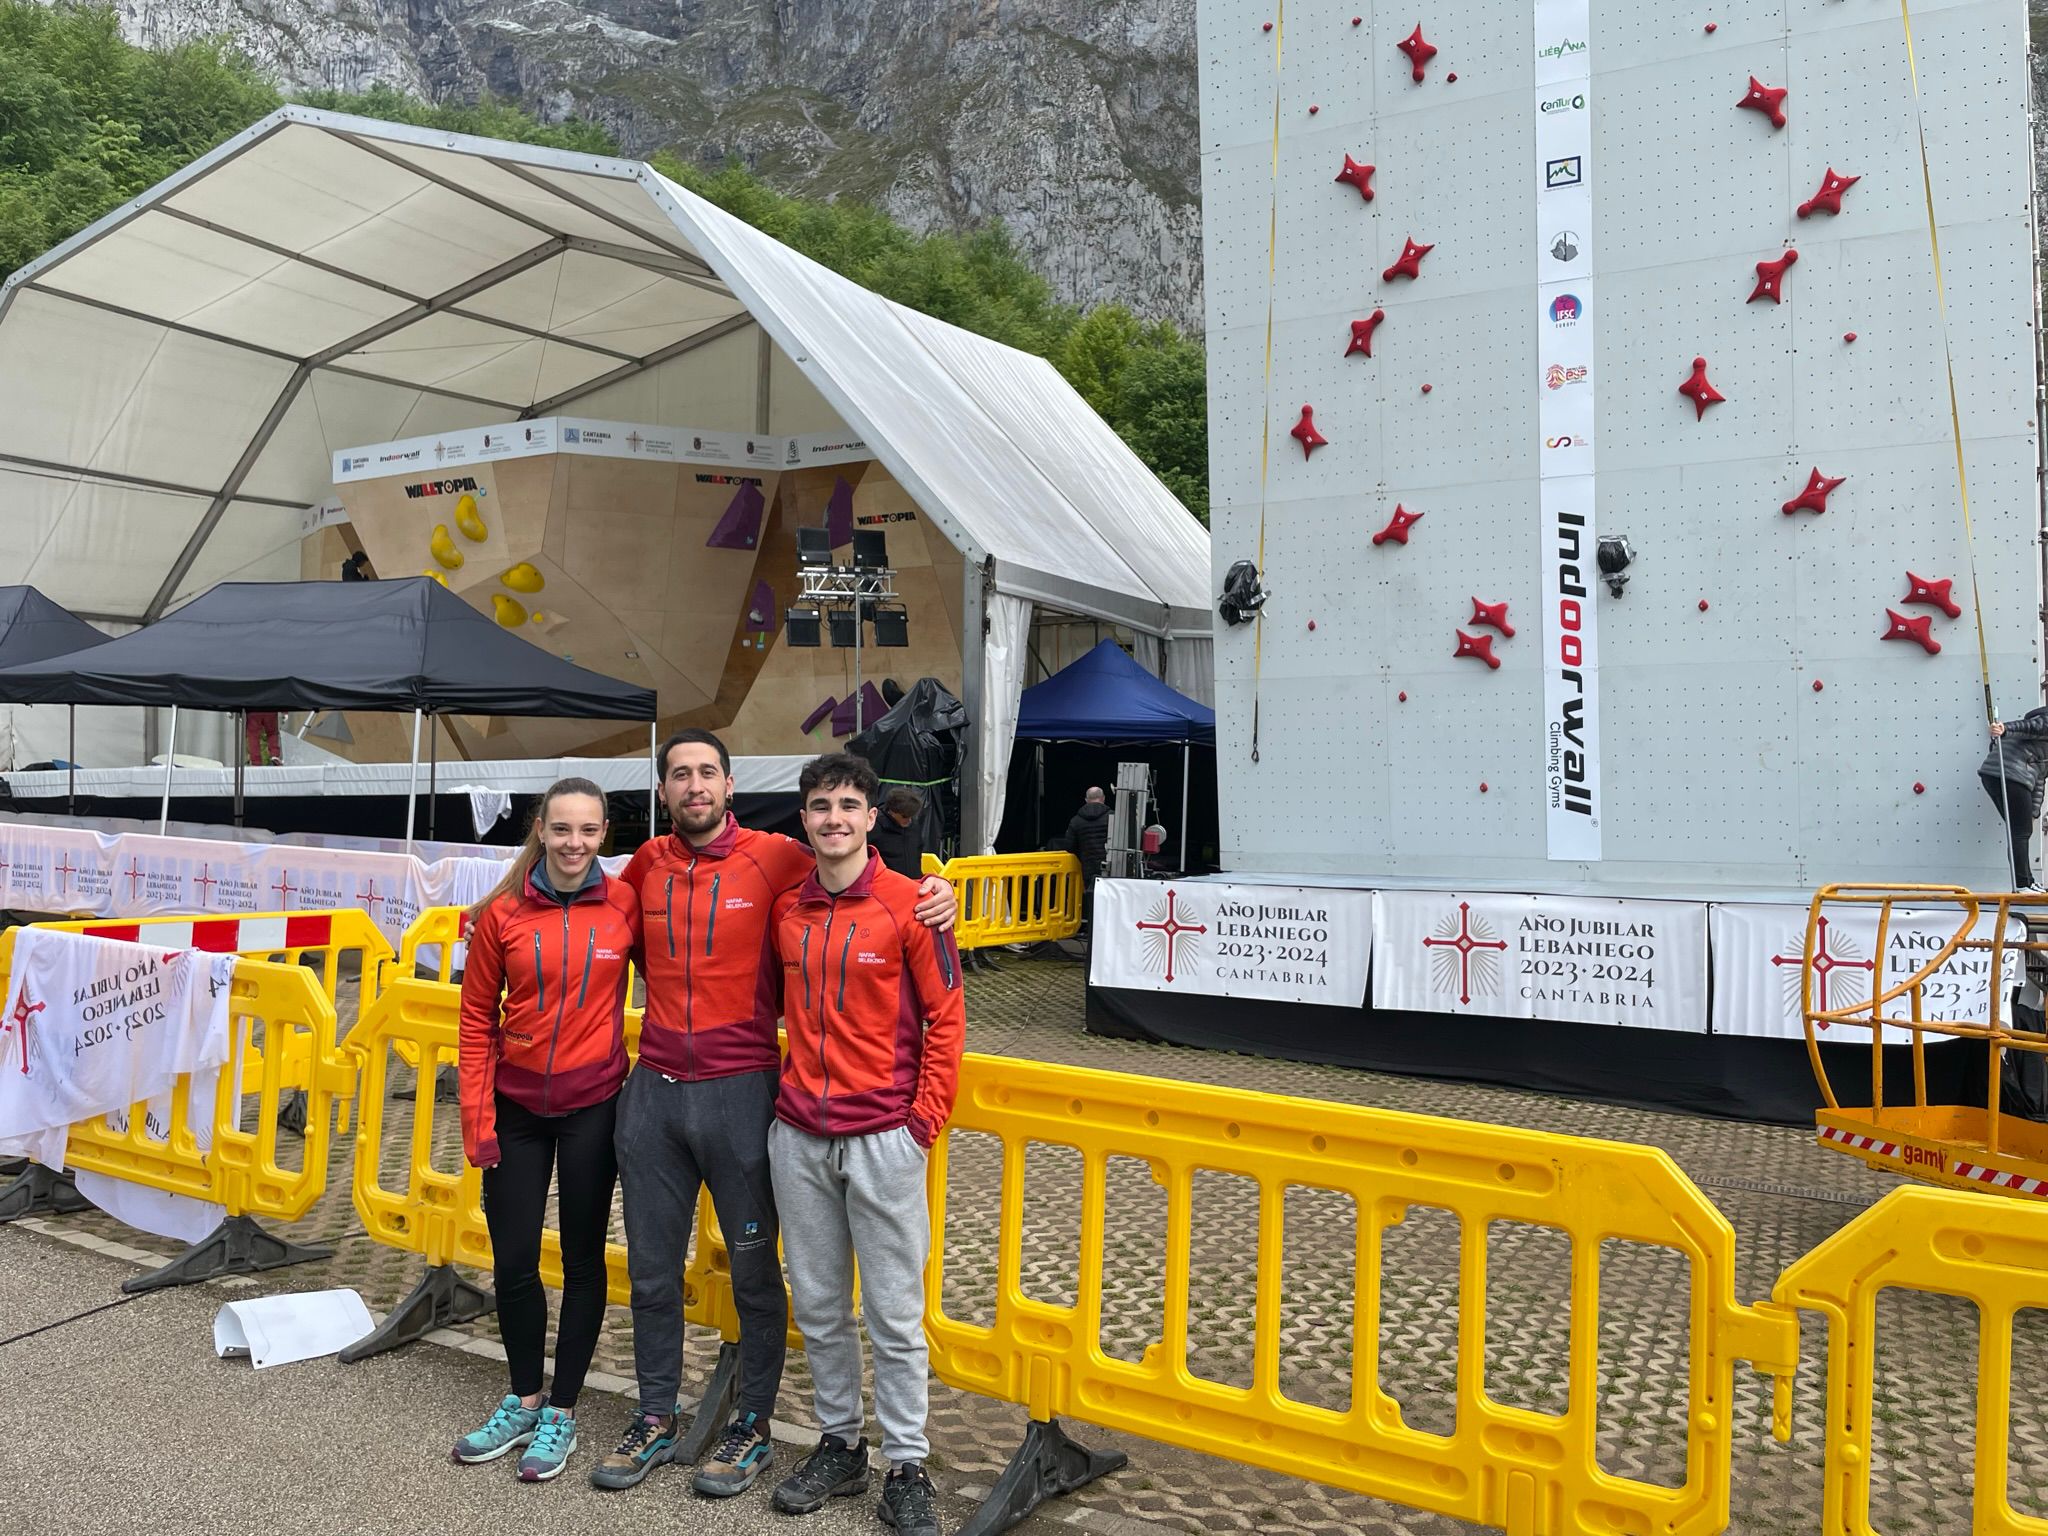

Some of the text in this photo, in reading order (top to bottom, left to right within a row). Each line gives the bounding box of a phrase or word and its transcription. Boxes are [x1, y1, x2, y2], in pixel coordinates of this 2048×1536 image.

[1557, 309, 1575, 320] IFSC
[405, 477, 478, 499] WALLTOPIA
[857, 512, 917, 526] WALLTOPIA
[1558, 512, 1592, 816] Indoorwall
[1548, 722, 1563, 809] Climbing Gyms
[1216, 902, 1328, 922] AÑO JUBILAR
[1217, 922, 1328, 942] LEBANIEGO
[1519, 914, 1656, 938] AÑO JUBILAR
[1520, 937, 1655, 960] LEBANIEGO
[1890, 931, 1945, 951] AÑO
[1216, 967, 1327, 986] CANTABRIA
[1520, 987, 1654, 1008] CANTABRIA
